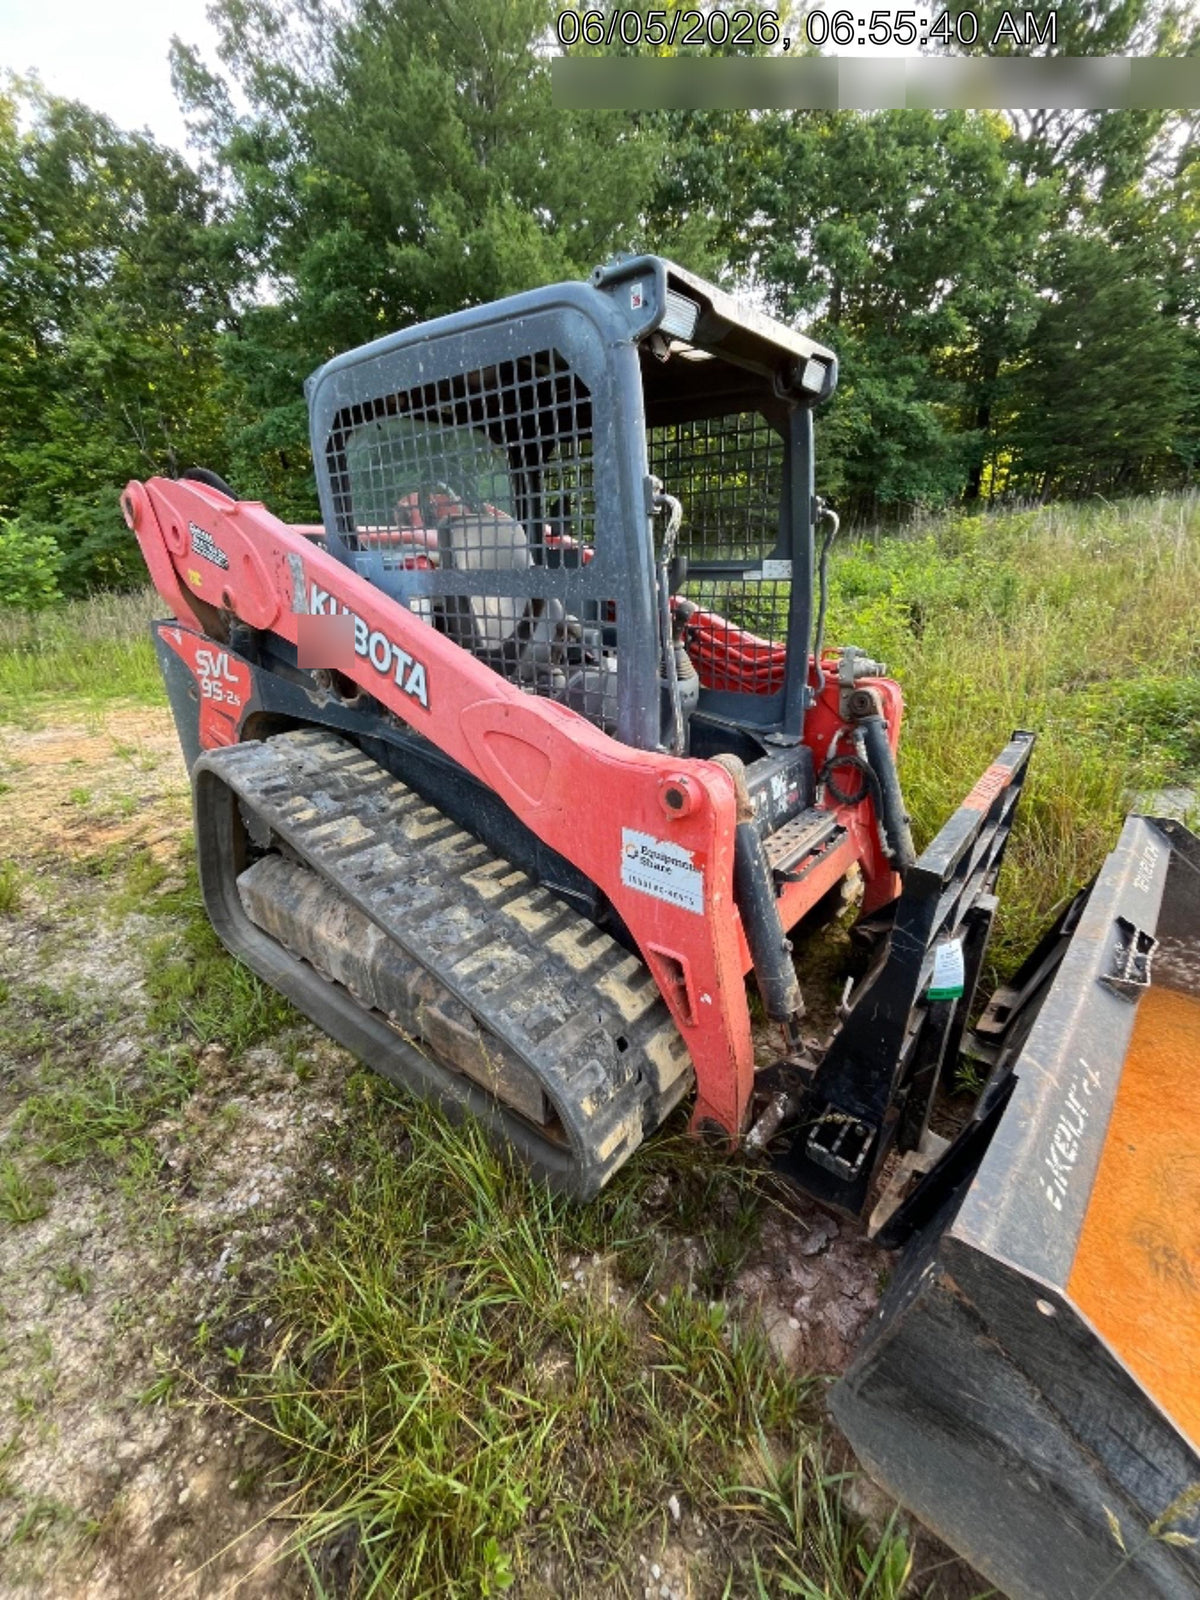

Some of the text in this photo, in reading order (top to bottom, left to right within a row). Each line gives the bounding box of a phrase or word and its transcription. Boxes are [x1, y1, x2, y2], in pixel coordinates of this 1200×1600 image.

[195, 650, 239, 682] SVL
[640, 856, 672, 875] Share
[641, 845, 700, 874] Equipmen
